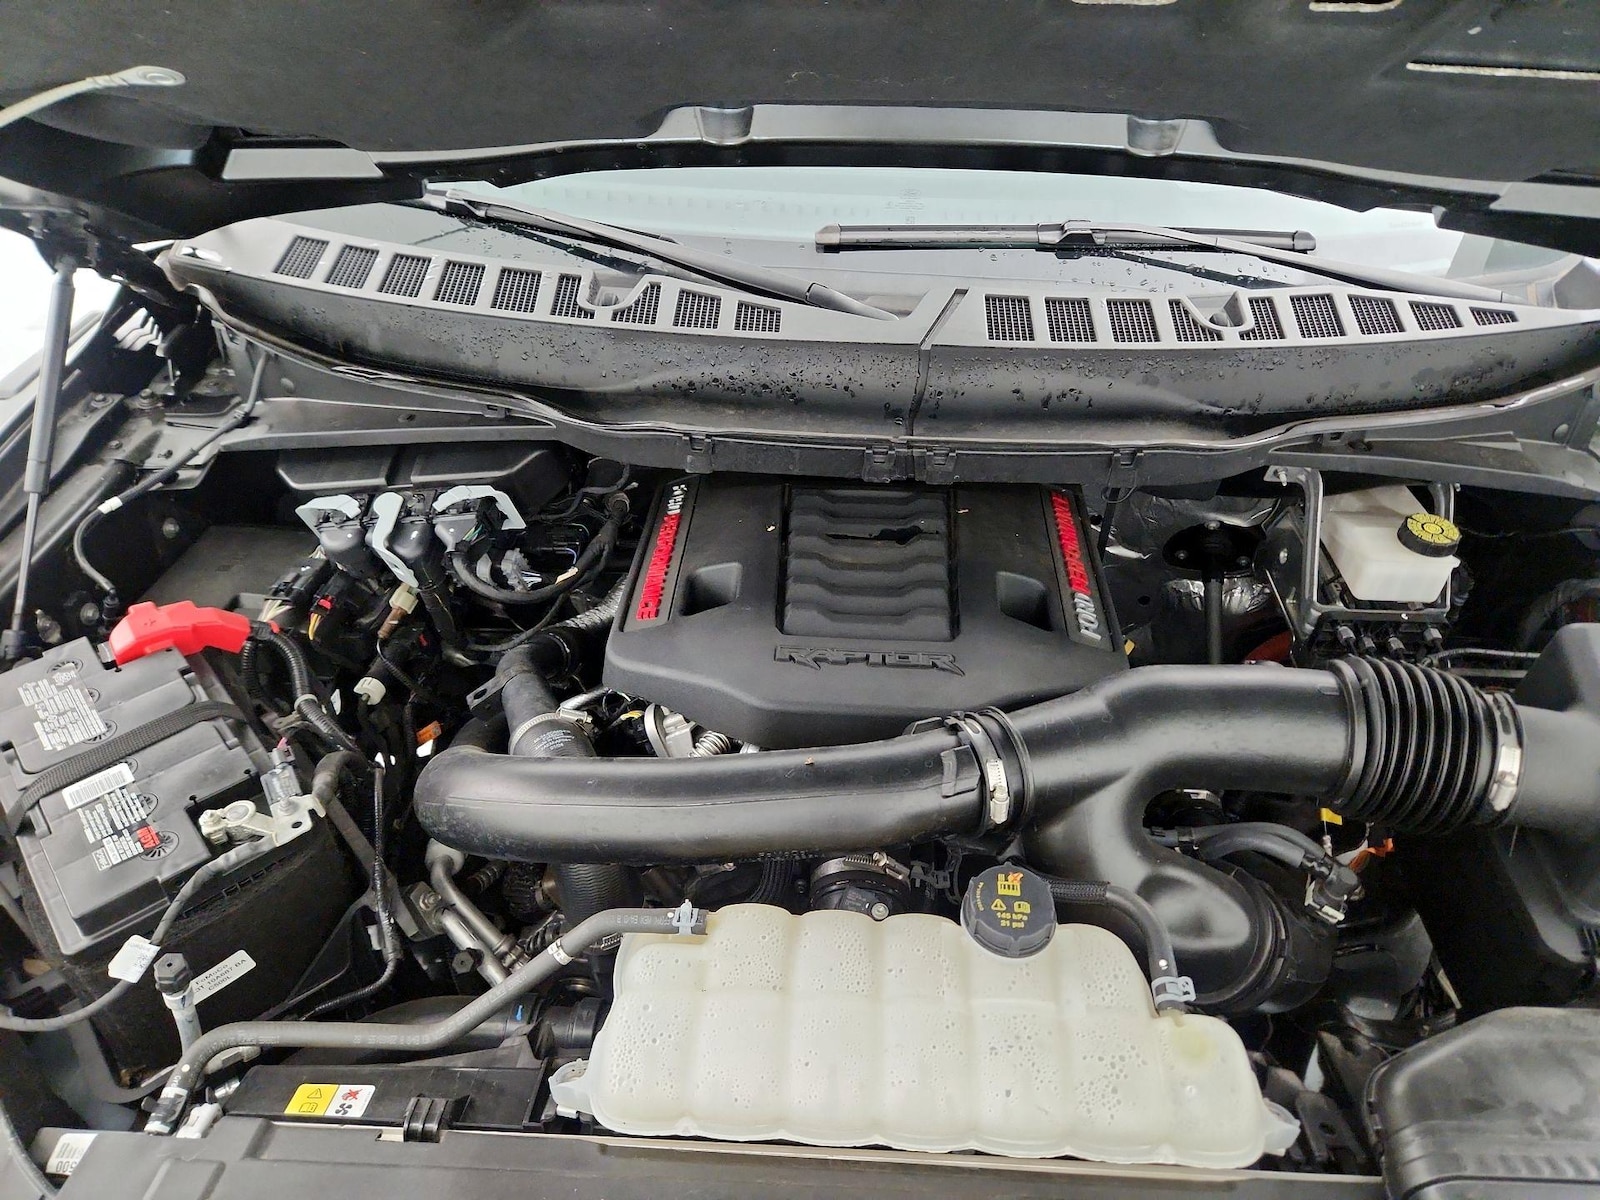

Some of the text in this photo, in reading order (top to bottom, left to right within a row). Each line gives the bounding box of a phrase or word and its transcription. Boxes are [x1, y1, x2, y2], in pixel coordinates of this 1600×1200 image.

[636, 513, 681, 621] PERFORMANCE
[1074, 592, 1102, 641] FORD
[773, 645, 966, 677] RAPTOR
[136, 826, 156, 849] AGM
[1000, 919, 1025, 929] 21 psi
[195, 964, 229, 985] FoMoCo
